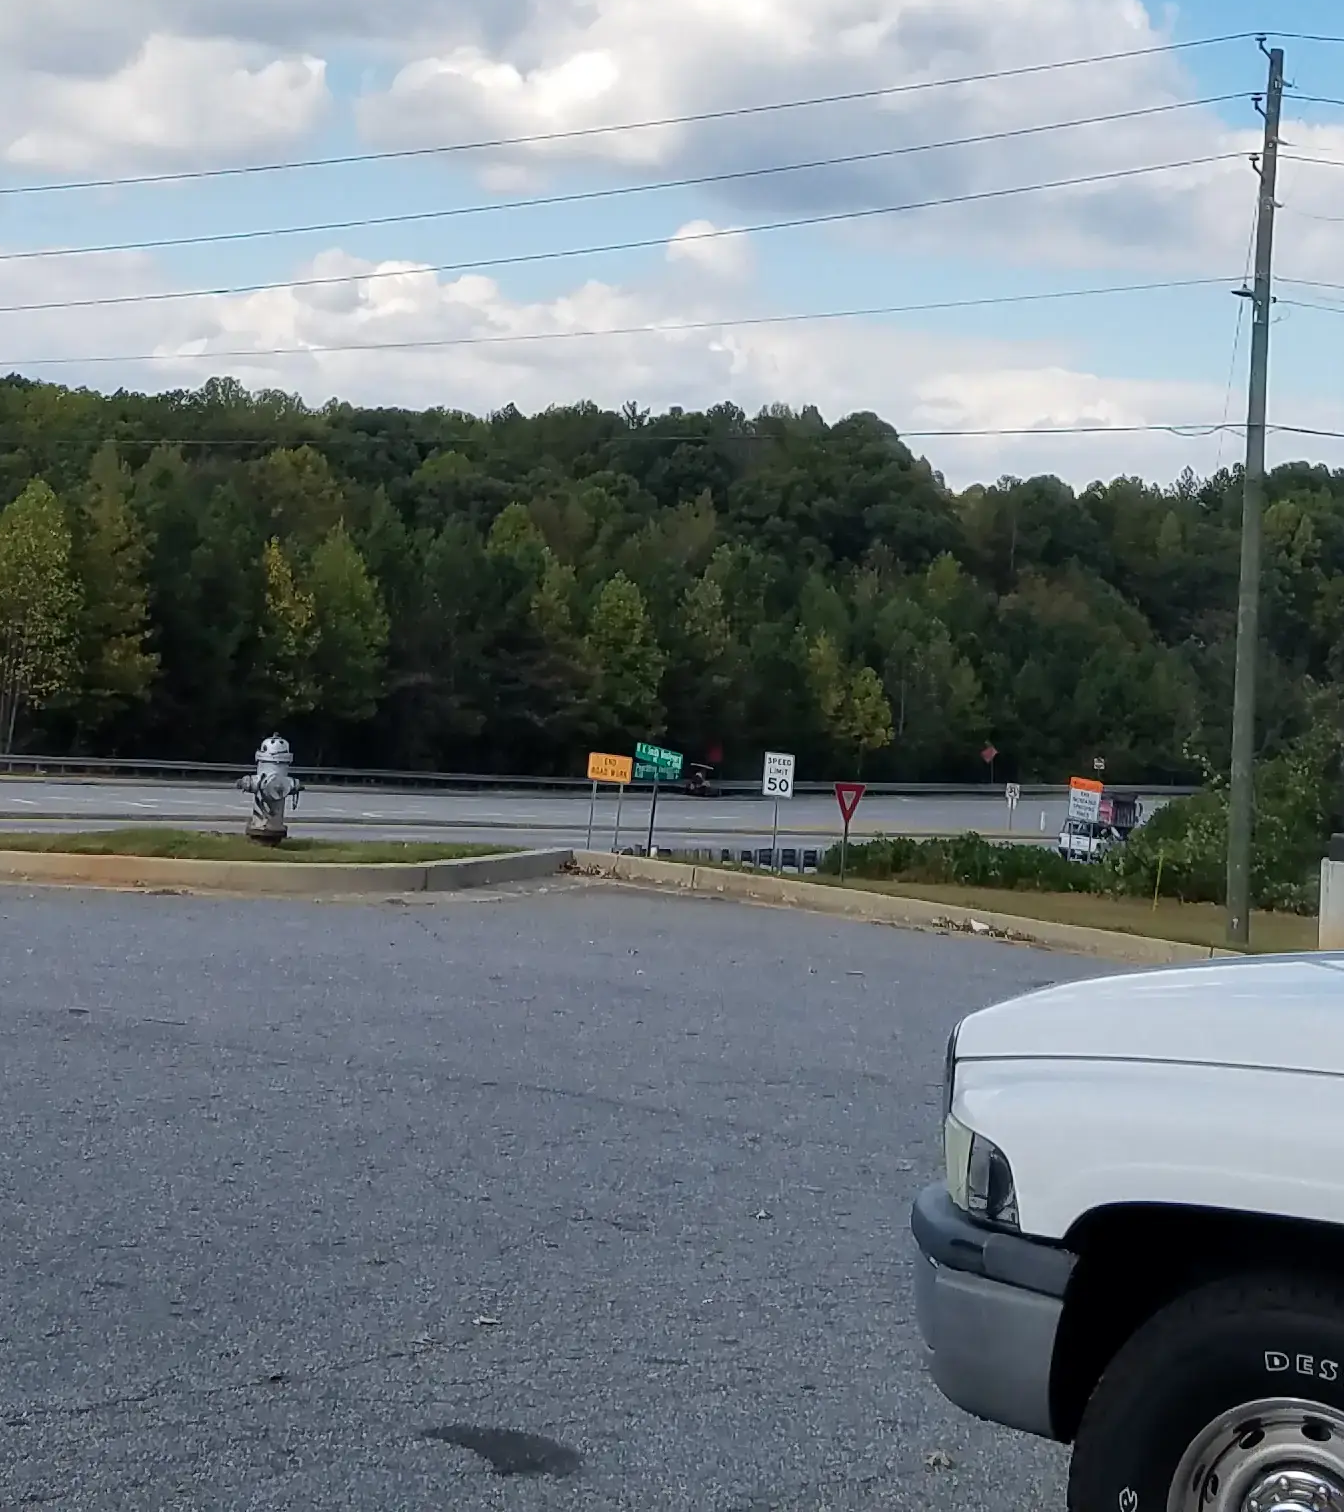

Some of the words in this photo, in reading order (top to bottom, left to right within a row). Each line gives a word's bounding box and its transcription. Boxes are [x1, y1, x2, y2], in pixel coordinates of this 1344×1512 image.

[768, 757, 792, 766] SPEED
[769, 767, 789, 776] LIMIT
[767, 777, 789, 792] 50
